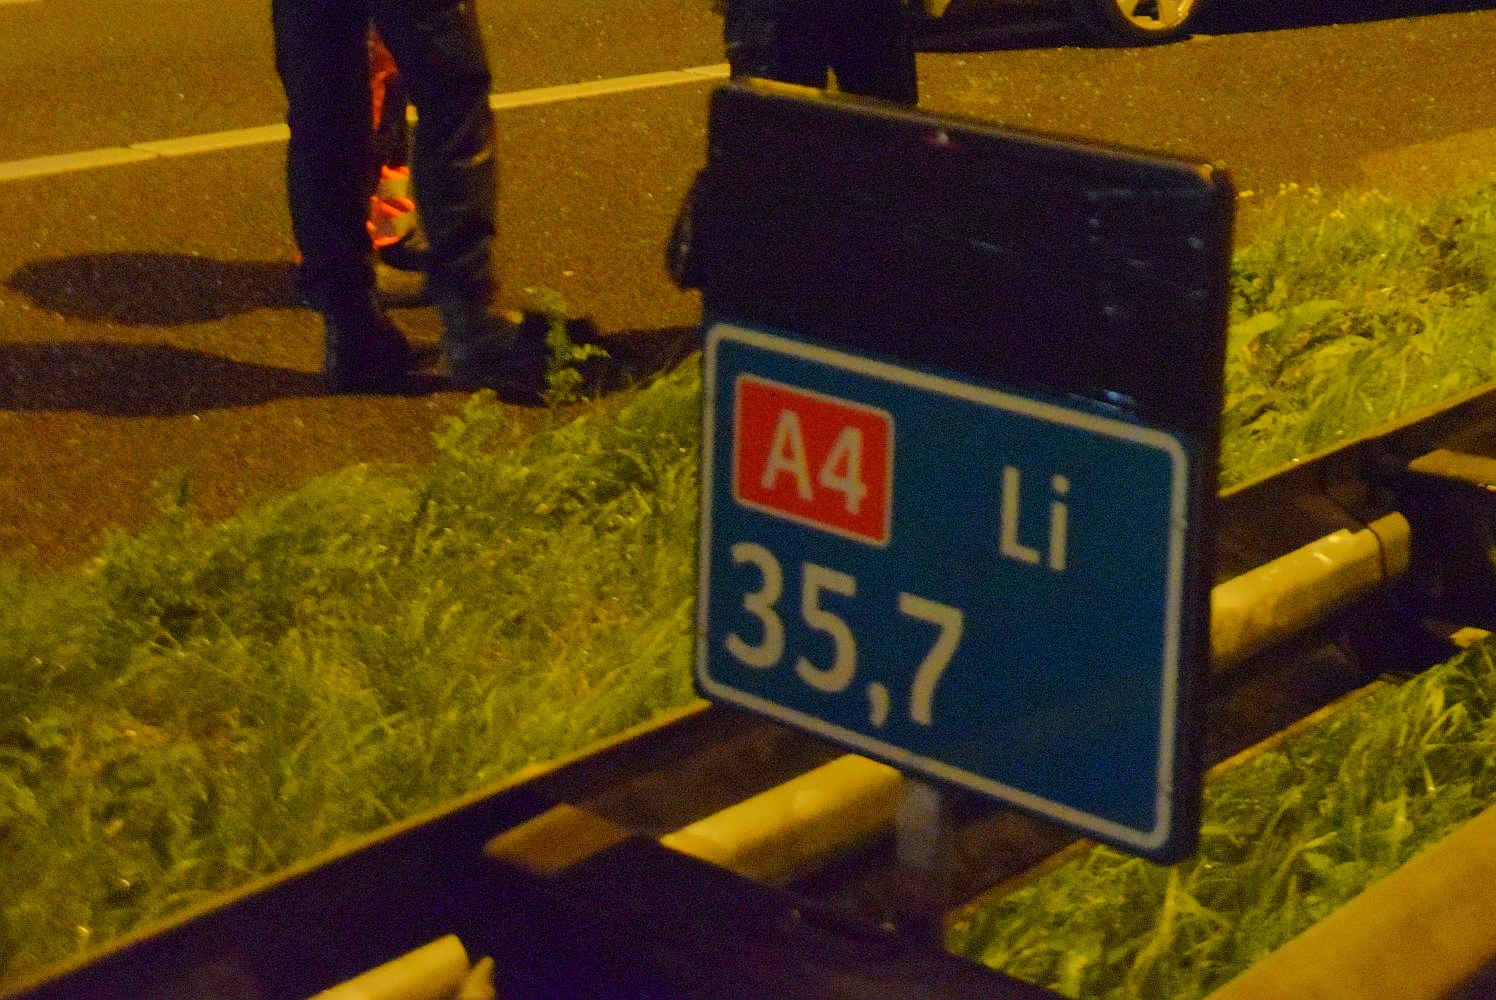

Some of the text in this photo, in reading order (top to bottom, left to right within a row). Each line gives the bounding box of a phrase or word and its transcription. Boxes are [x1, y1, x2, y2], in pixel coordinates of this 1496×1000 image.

[760, 409, 867, 516] A4
[1001, 465, 1069, 572] Li
[725, 541, 964, 729] 35,7
